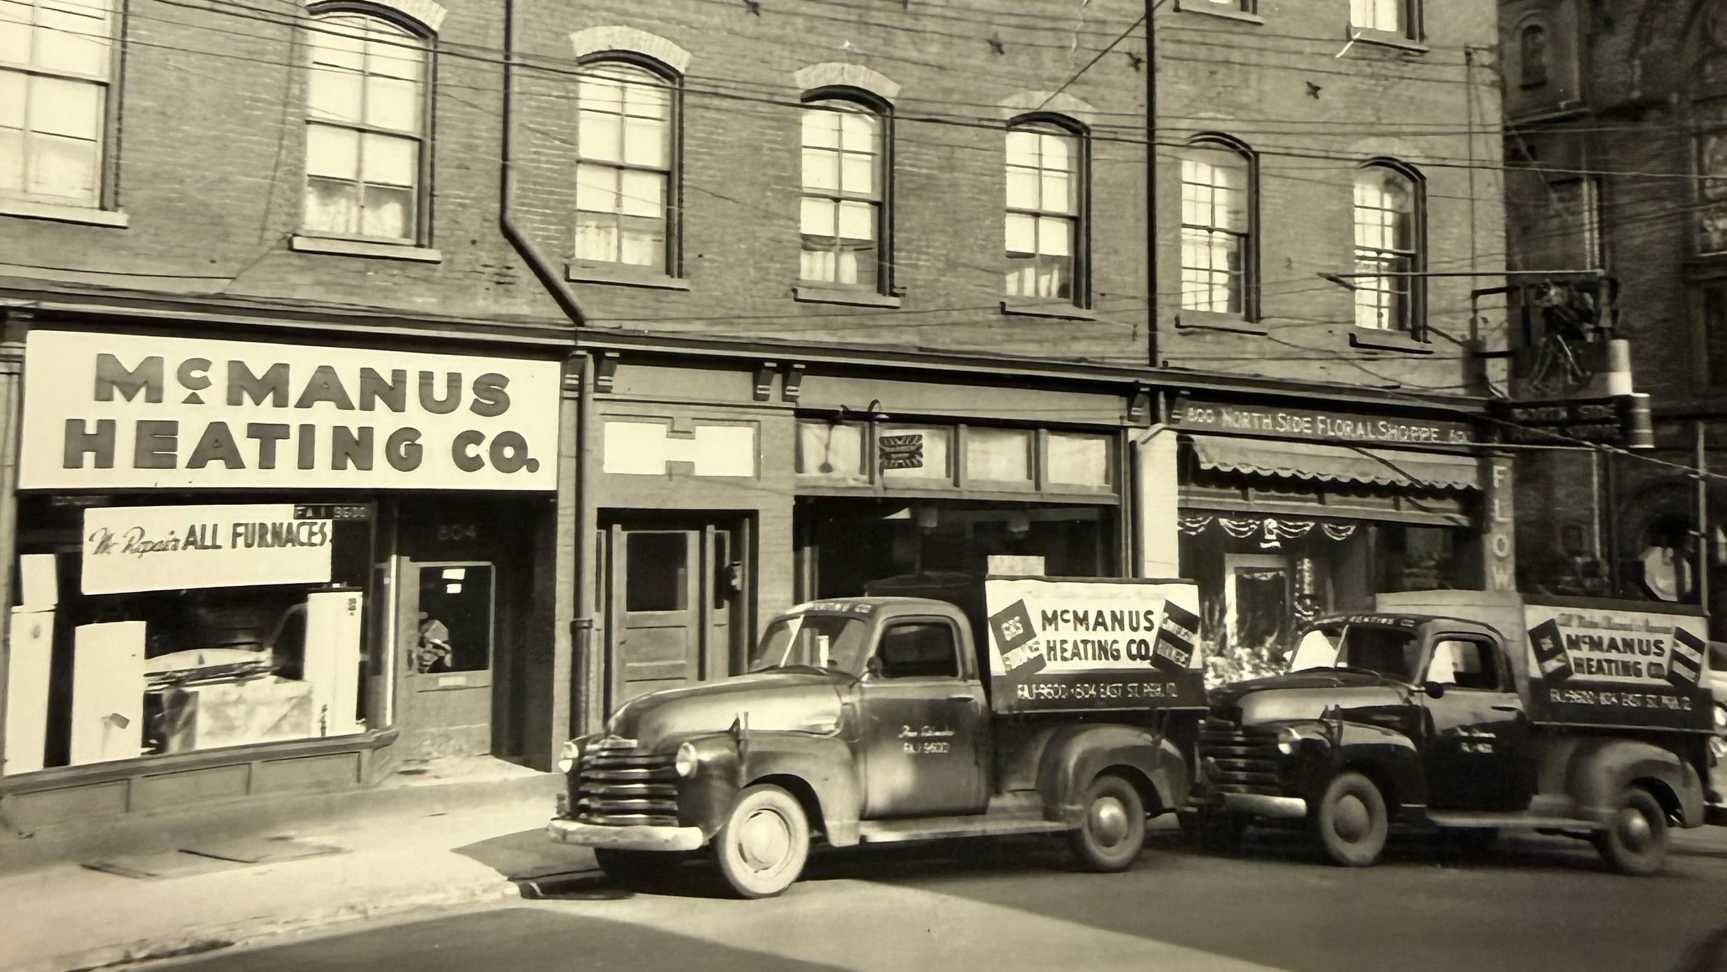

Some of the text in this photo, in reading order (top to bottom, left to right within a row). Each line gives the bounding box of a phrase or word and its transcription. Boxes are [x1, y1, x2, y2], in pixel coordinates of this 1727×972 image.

[94, 352, 511, 417] McMANUS
[1221, 408, 1273, 431] NORTH
[1317, 415, 1376, 439] FLORAL
[1378, 420, 1440, 444] SHOPPE
[63, 418, 540, 474] HEATING CO.
[182, 524, 222, 551] ALL
[1041, 609, 1155, 632] McMANUS
[1046, 639, 1121, 662] HEATING
[1565, 633, 1666, 658] McMANUS
[1573, 657, 1644, 679] HEATING
